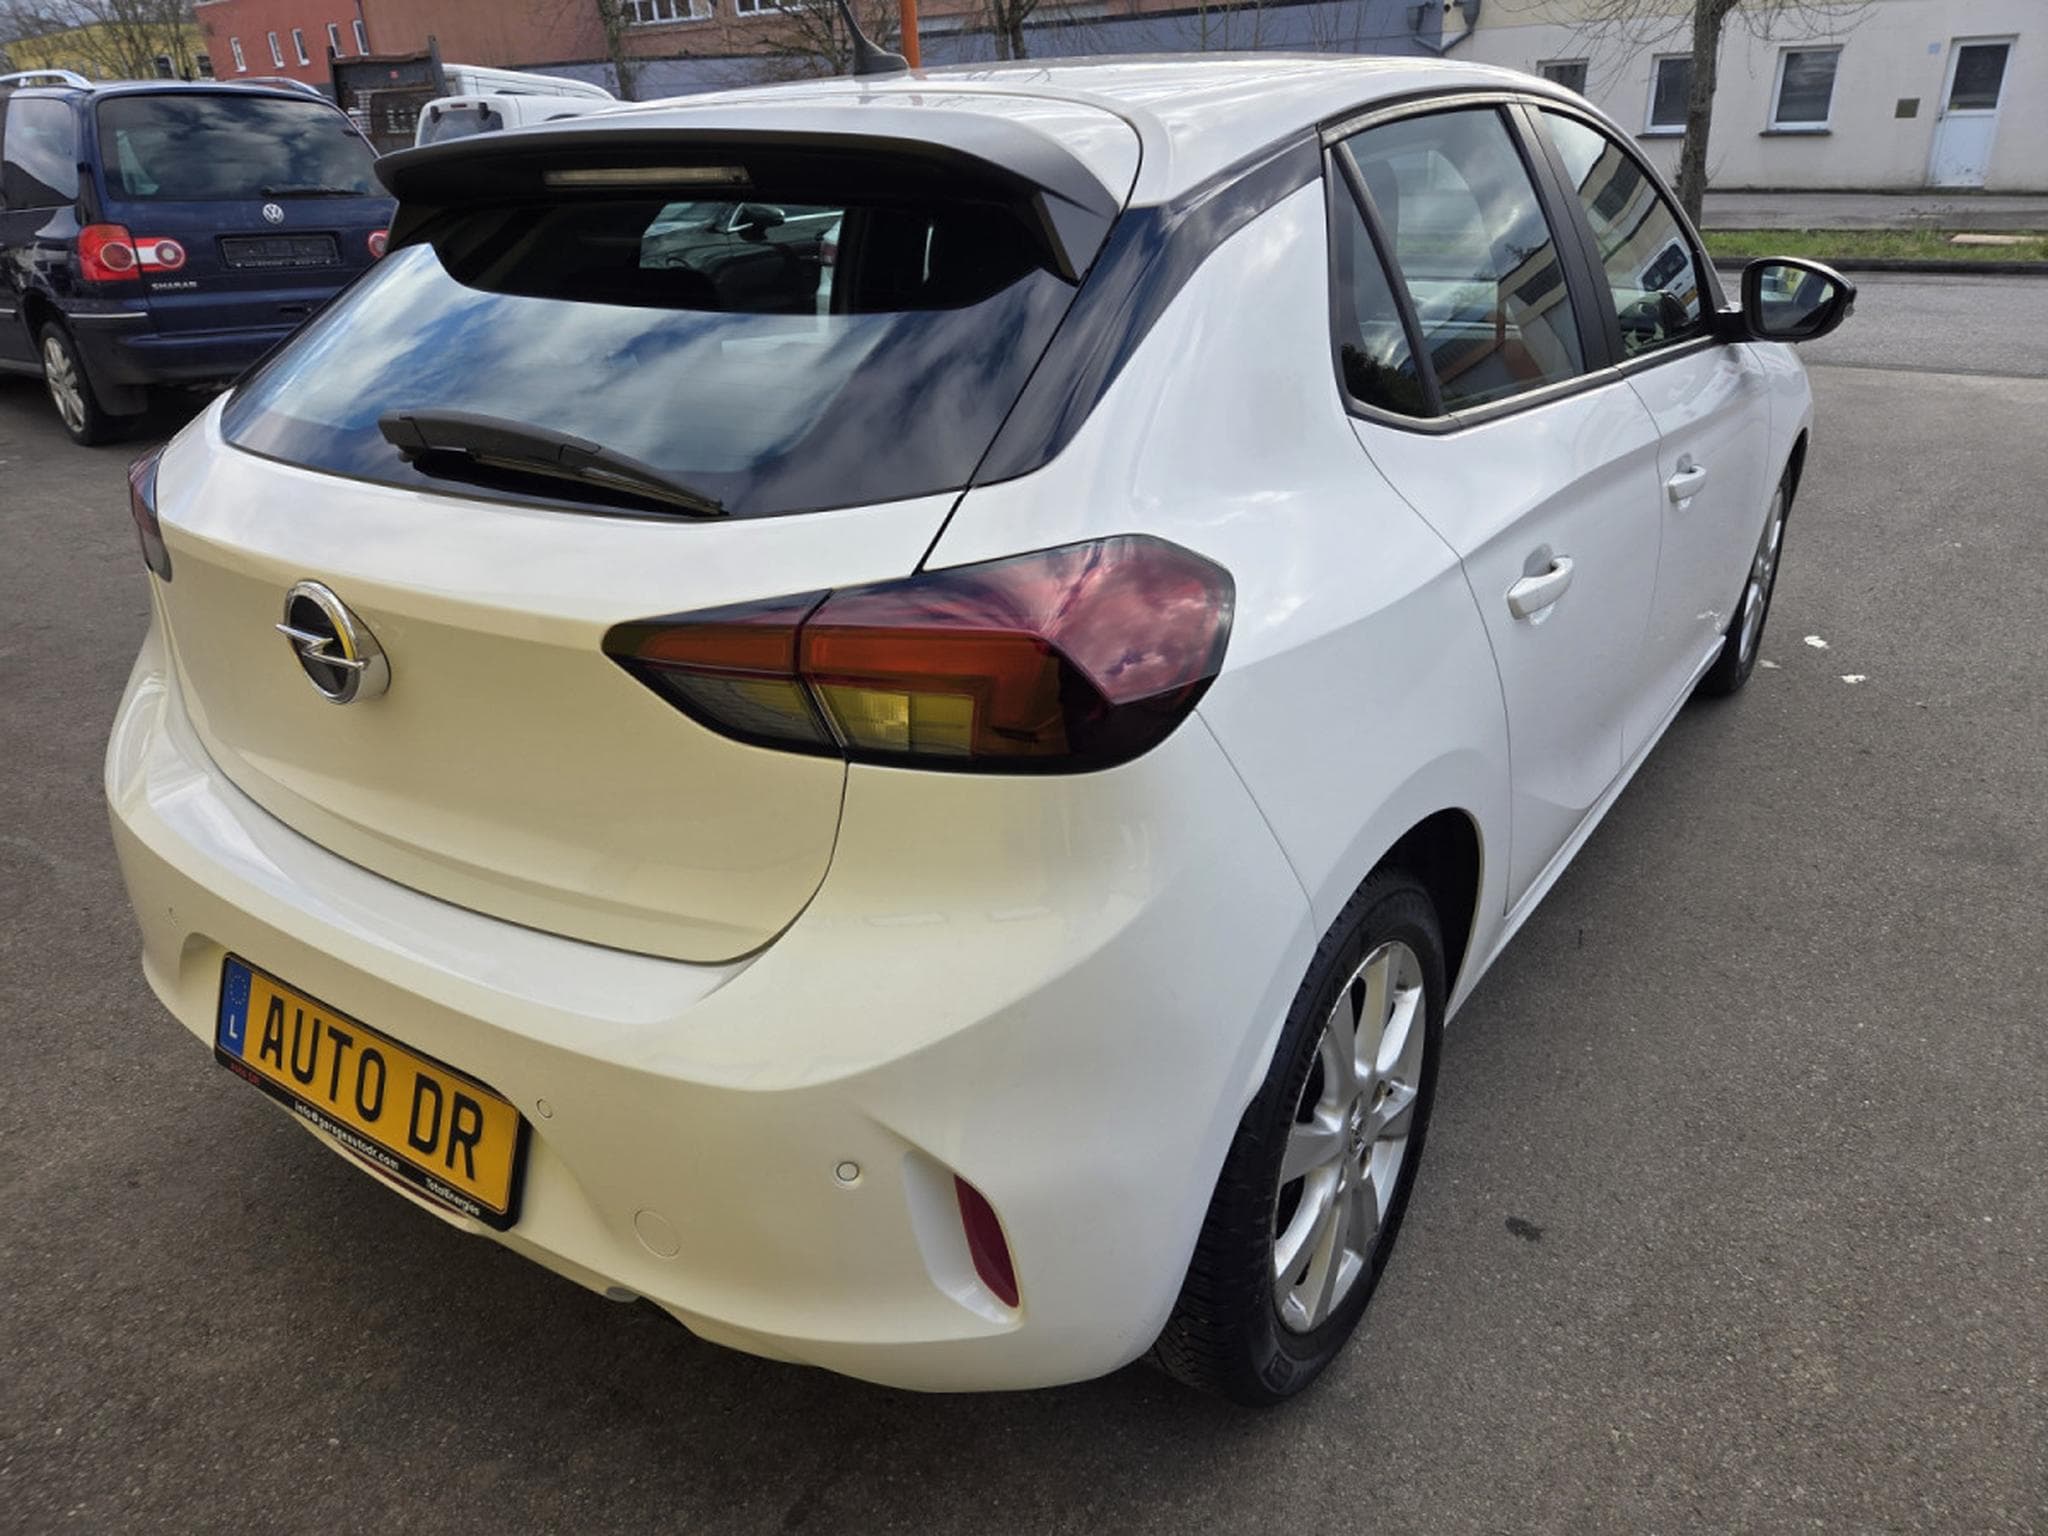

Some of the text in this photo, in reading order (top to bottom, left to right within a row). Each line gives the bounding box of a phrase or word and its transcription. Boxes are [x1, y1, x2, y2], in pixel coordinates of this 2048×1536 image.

[228, 1013, 238, 1039] L
[259, 995, 484, 1181] AUTO DR
